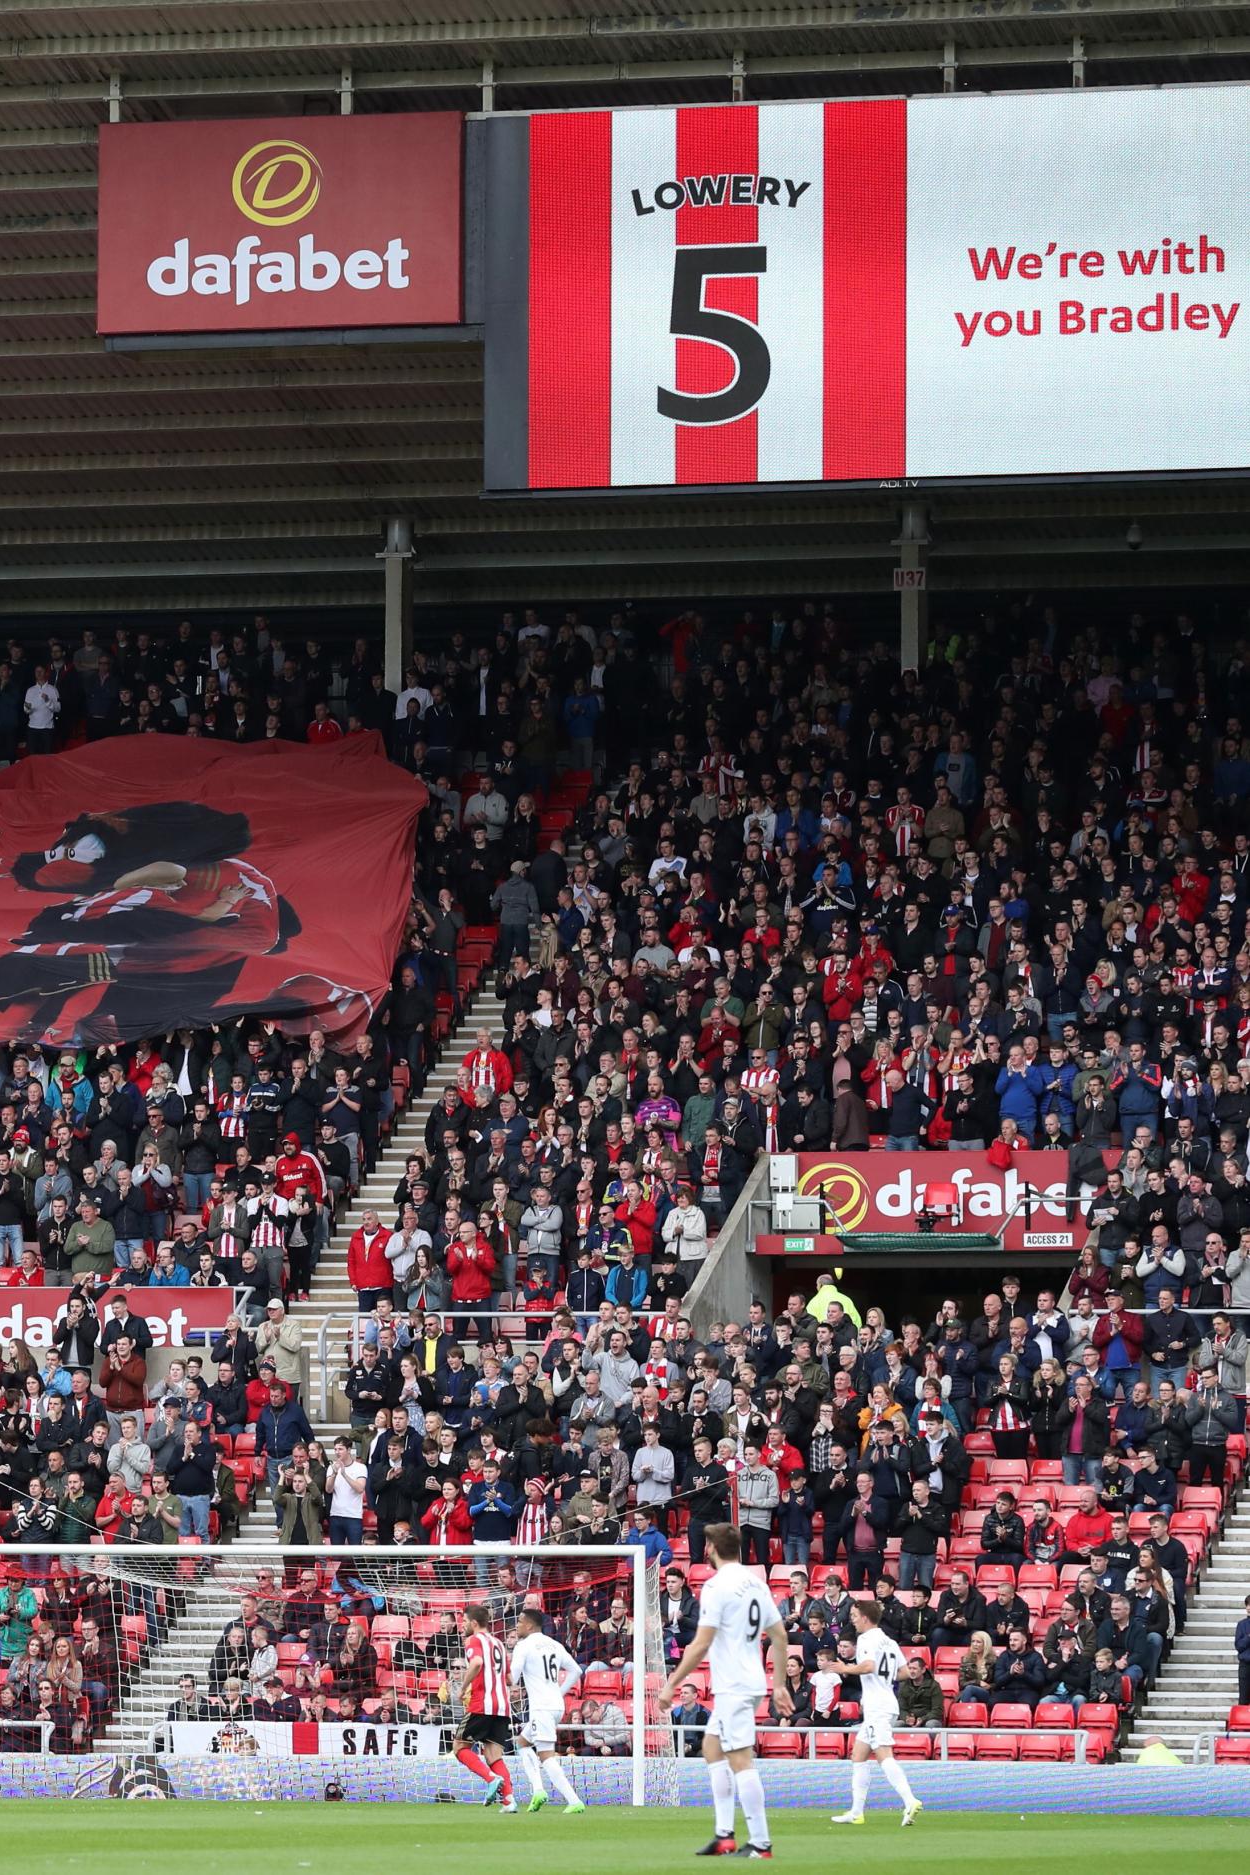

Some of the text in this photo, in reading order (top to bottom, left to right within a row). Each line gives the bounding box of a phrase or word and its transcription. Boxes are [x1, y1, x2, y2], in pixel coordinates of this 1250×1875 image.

[631, 175, 811, 216] LOWERY
[147, 234, 409, 305] dafabet
[967, 235, 1225, 281] We're with
[657, 245, 771, 424] 5
[954, 292, 1241, 347] you Bradley
[895, 571, 924, 587] U37
[785, 1240, 805, 1249] EXIT
[1026, 1235, 1069, 1246] ACCESS 21
[746, 1598, 761, 1643] 9
[493, 1644, 503, 1675] 9
[542, 1653, 559, 1684] 16
[342, 1728, 419, 1756] SAFC
